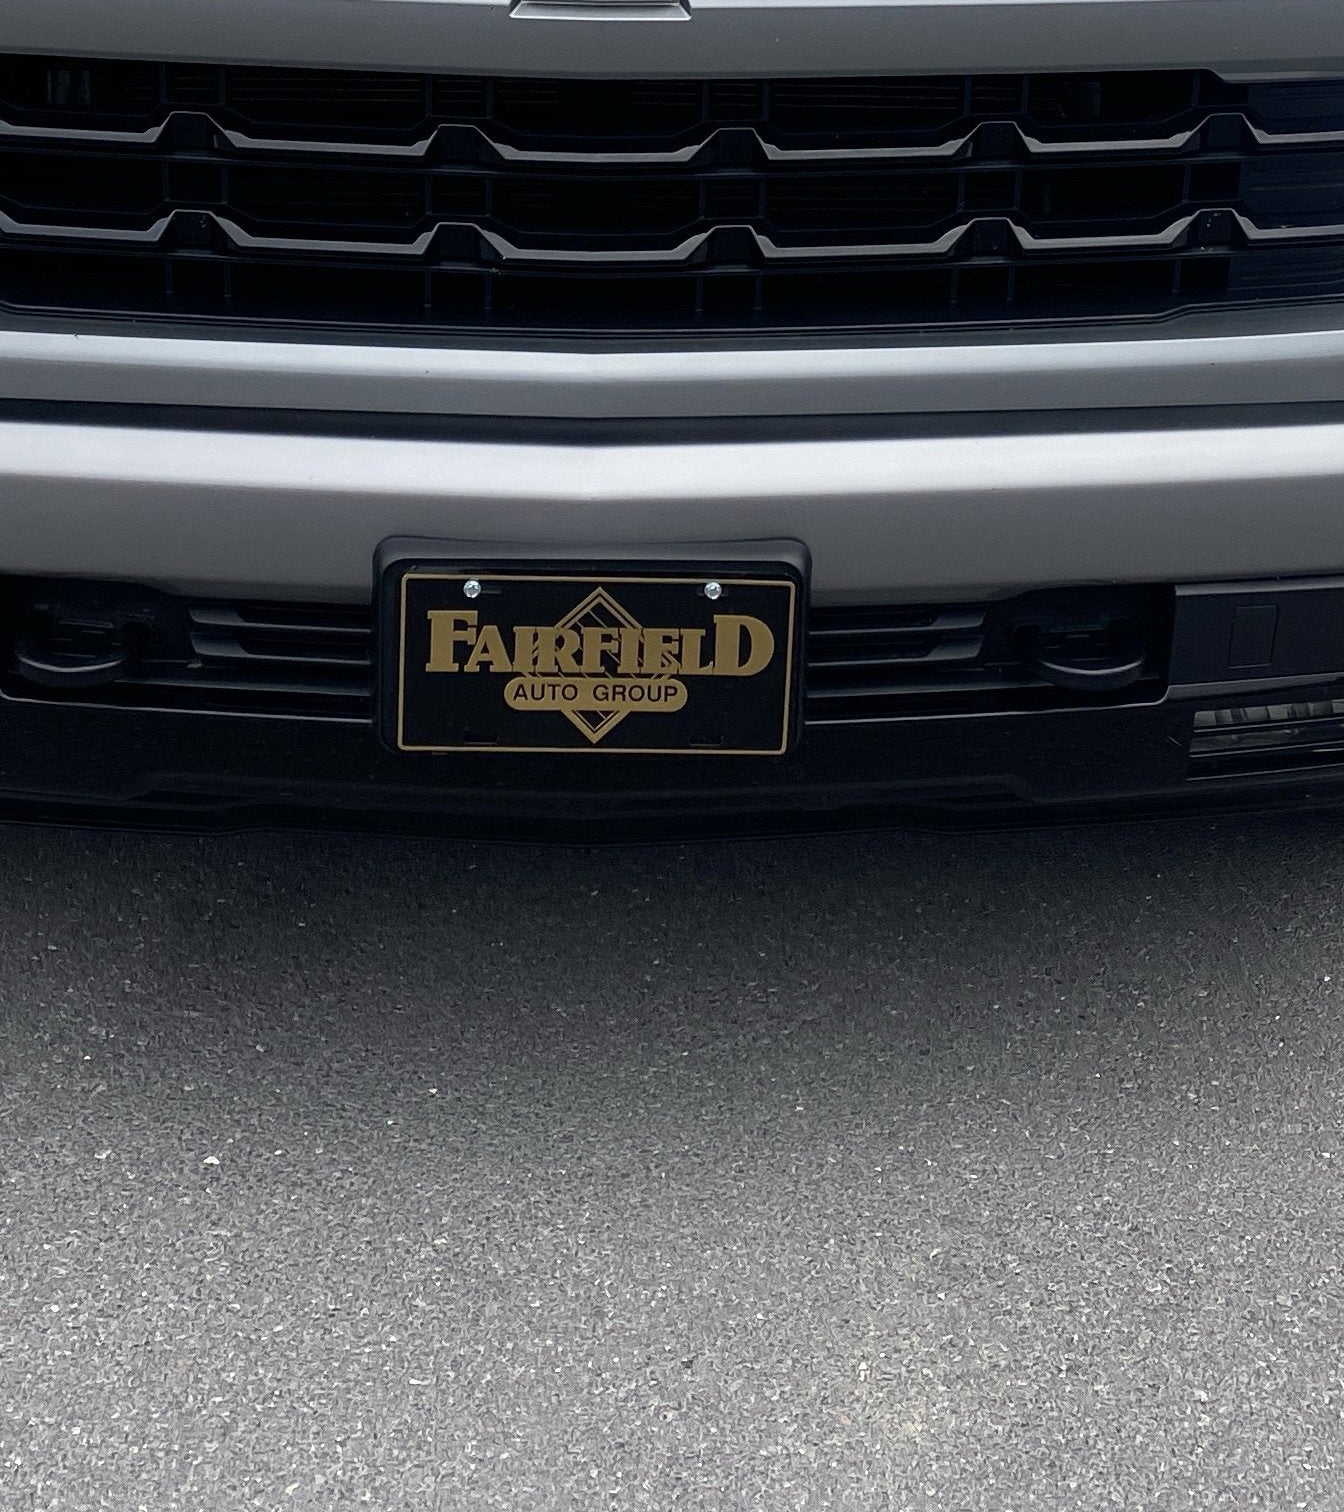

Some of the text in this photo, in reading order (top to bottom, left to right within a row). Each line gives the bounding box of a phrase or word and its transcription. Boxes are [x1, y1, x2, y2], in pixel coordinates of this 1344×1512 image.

[425, 609, 775, 677] FAIRFIELD
[512, 682, 679, 704] AUTO GROUP
